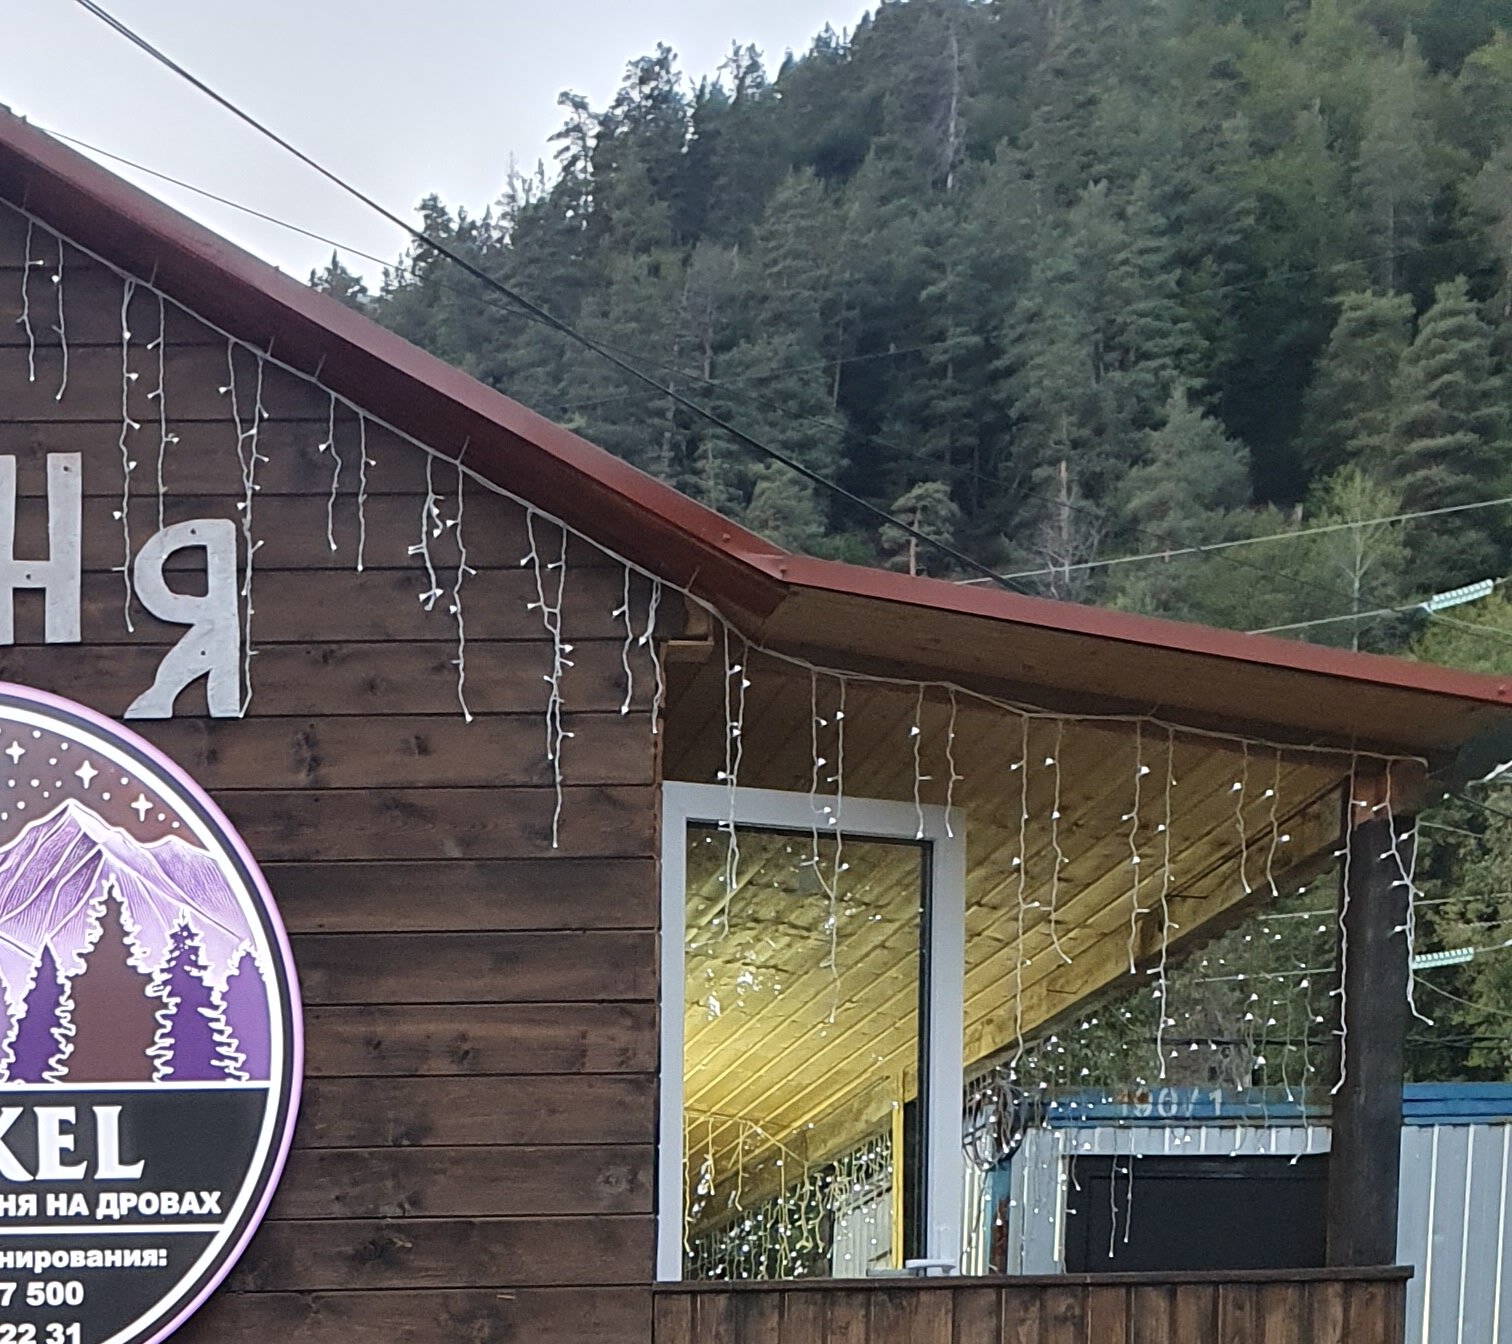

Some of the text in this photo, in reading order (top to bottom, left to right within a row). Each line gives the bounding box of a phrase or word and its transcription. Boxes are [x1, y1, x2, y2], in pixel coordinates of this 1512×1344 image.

[45, 1192, 87, 1216] НА
[95, 1191, 222, 1220] ДРОВАХ
[25, 1280, 85, 1306] 500
